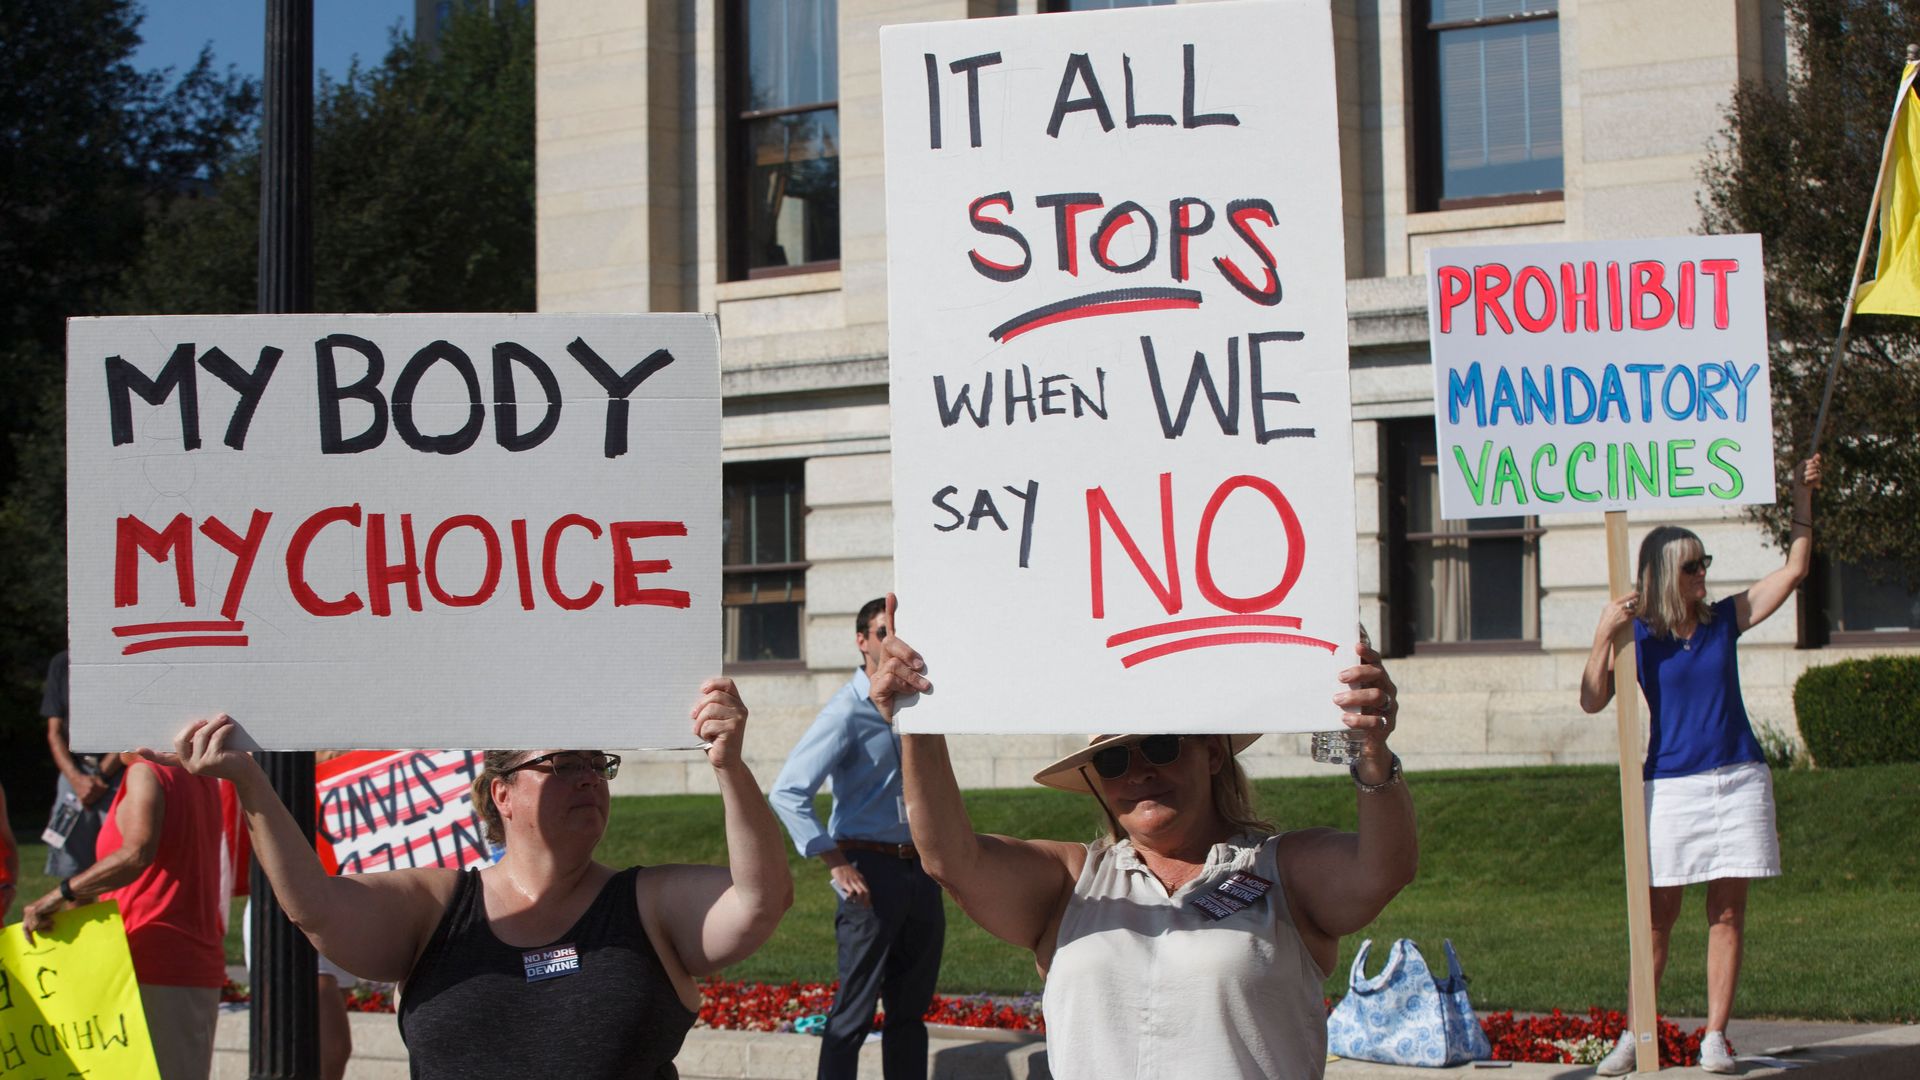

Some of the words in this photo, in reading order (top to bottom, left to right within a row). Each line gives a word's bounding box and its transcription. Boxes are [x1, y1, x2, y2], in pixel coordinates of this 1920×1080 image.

[924, 52, 1002, 149] IT
[1046, 44, 1240, 139] ALL
[968, 191, 1282, 306] STOPS
[1438, 259, 1739, 335] PROHIBIT
[105, 342, 283, 451] MY
[316, 333, 675, 458] BODY
[934, 364, 1108, 428] WHEN
[1140, 332, 1315, 444] WE
[1449, 361, 1760, 427] MANDATORY
[1452, 438, 1744, 505] VACCINES
[114, 509, 273, 621] MY
[286, 502, 691, 617] CHOICE
[932, 480, 1039, 568] SAY
[1086, 472, 1306, 619] NO
[318, 752, 443, 844] STAND
[1218, 882, 1258, 902] DEWINE
[524, 953, 541, 964] NO
[543, 947, 577, 961] MORE
[526, 959, 579, 977] DEWINE
